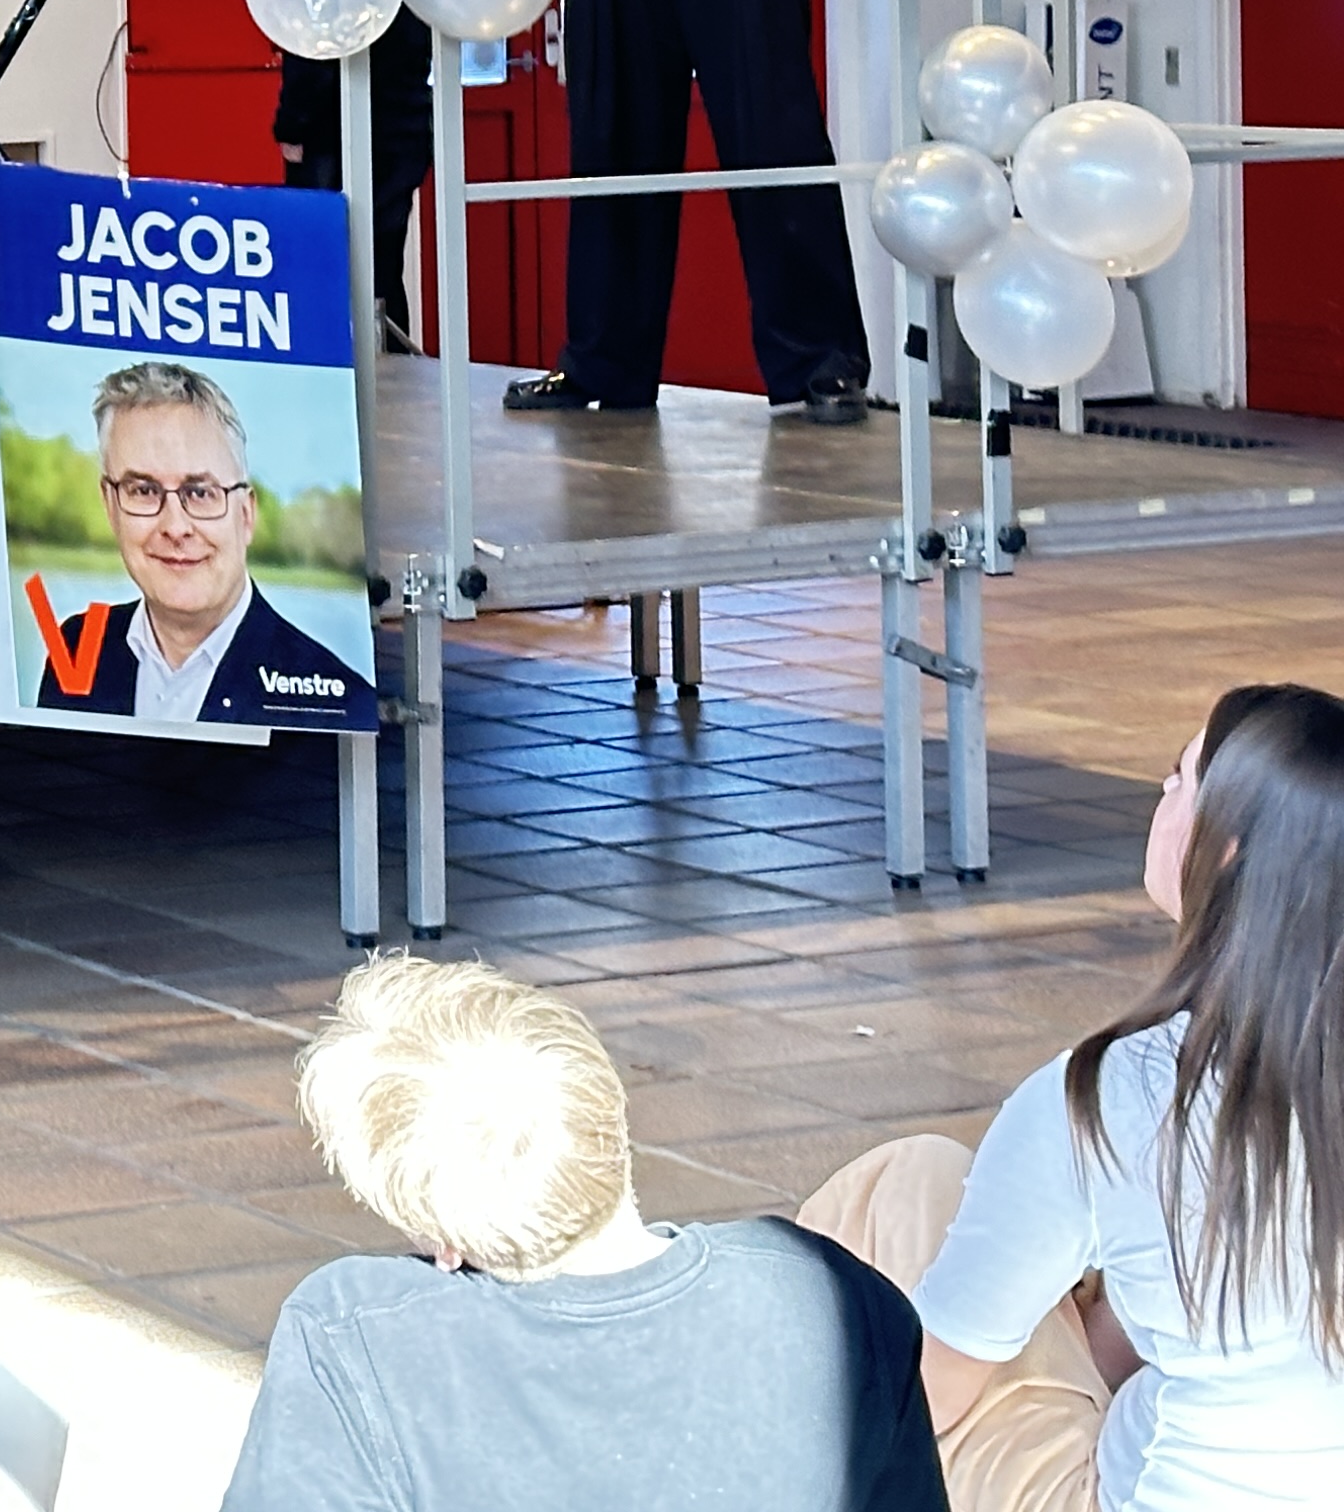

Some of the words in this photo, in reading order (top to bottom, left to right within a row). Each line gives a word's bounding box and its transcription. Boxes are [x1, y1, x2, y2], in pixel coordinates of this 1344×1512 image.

[57, 203, 273, 278] JACOB
[47, 273, 291, 351] JENSEN
[24, 572, 110, 696] V
[259, 665, 346, 697] Venstre
